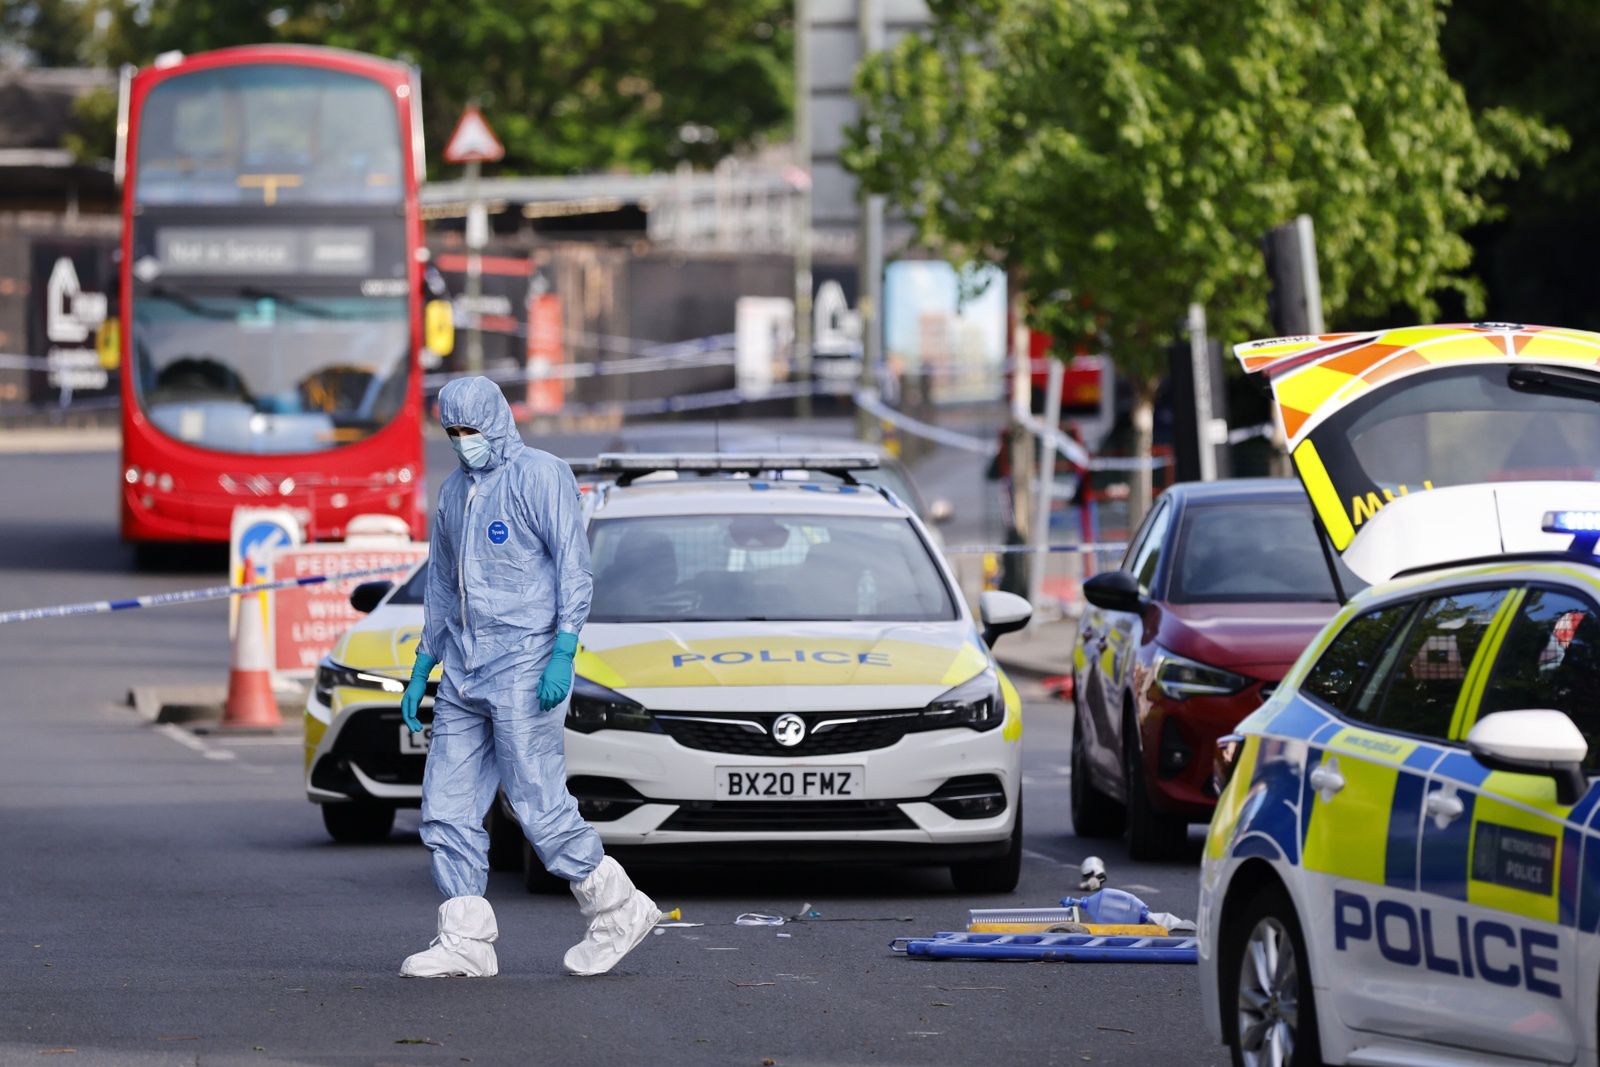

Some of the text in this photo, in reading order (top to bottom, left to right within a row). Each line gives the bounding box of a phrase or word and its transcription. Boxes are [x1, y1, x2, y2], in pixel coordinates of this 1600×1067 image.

[672, 649, 893, 668] POLICE
[728, 772, 852, 796] BX20 FMZ
[1505, 859, 1544, 884] POLICE
[1334, 888, 1563, 999] POLICE
